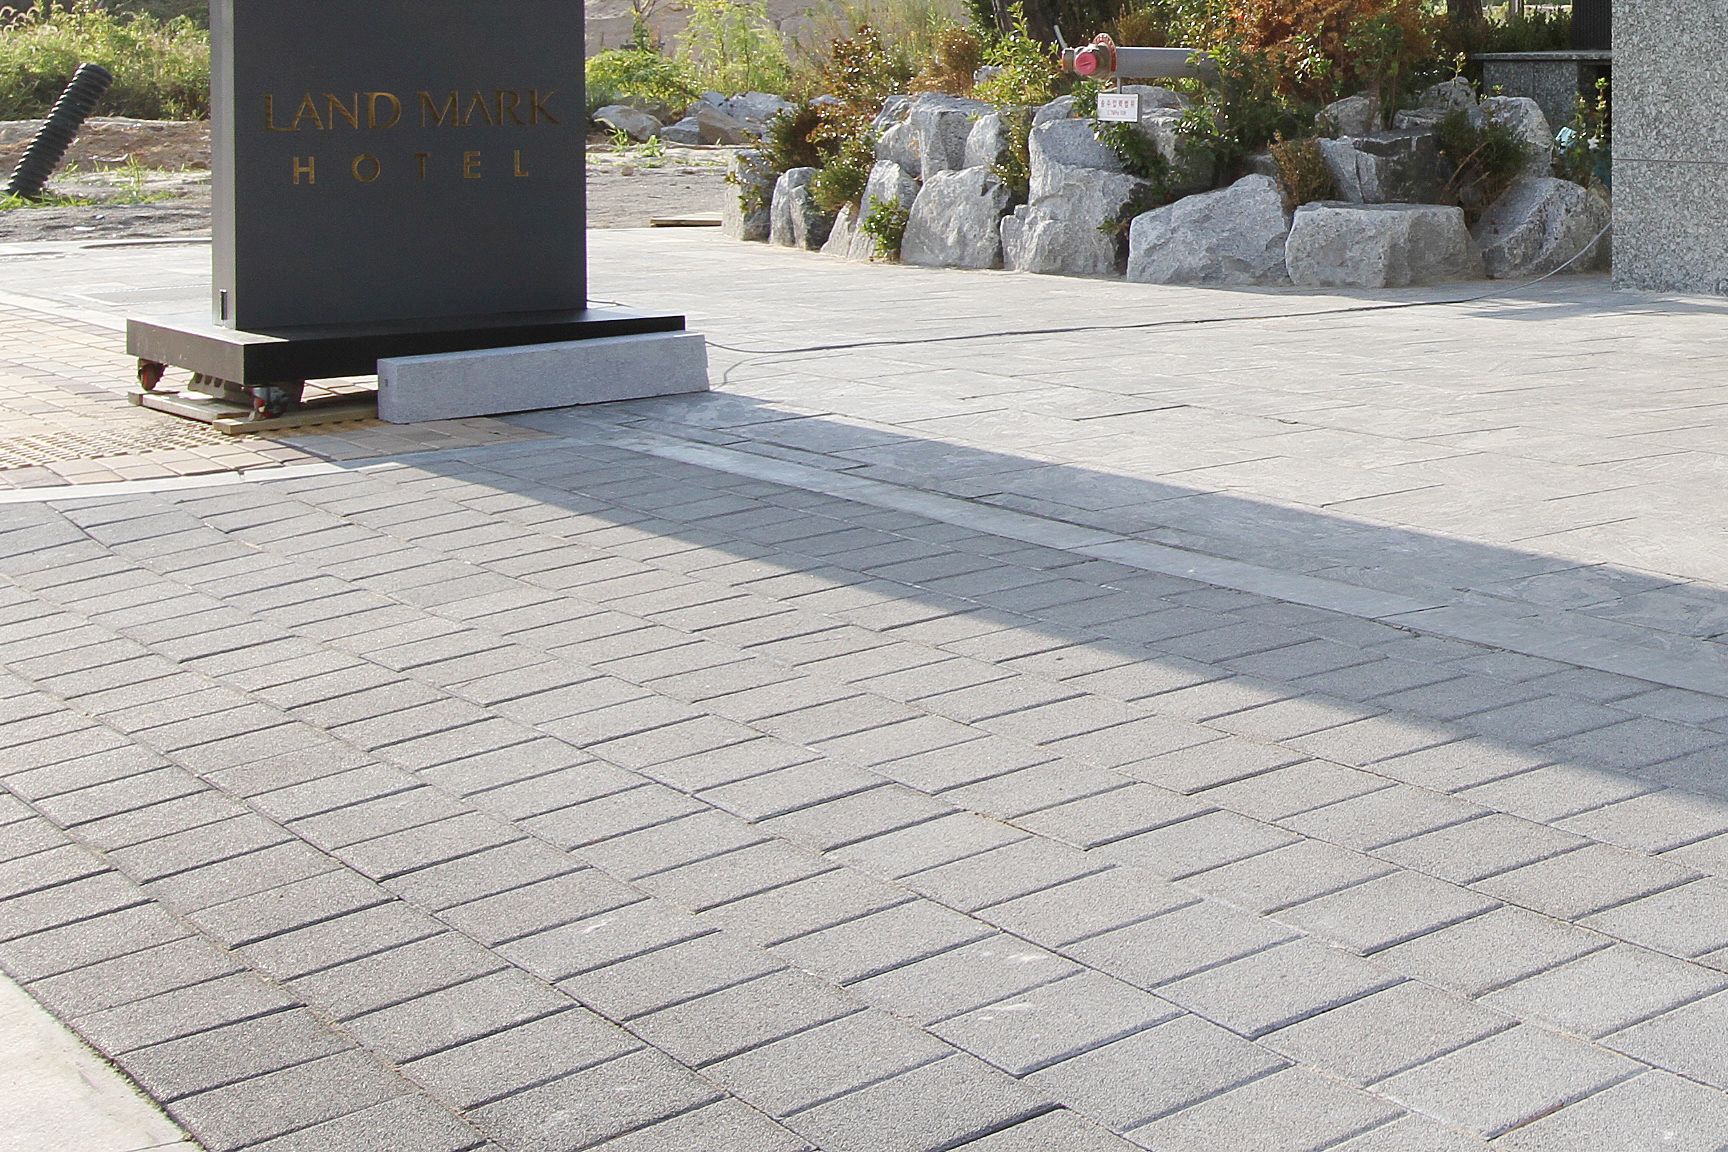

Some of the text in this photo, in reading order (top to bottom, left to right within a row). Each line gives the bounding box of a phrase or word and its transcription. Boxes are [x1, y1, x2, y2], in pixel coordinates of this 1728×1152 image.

[263, 88, 559, 132] LAND MARK
[292, 148, 530, 185] HOTEL
